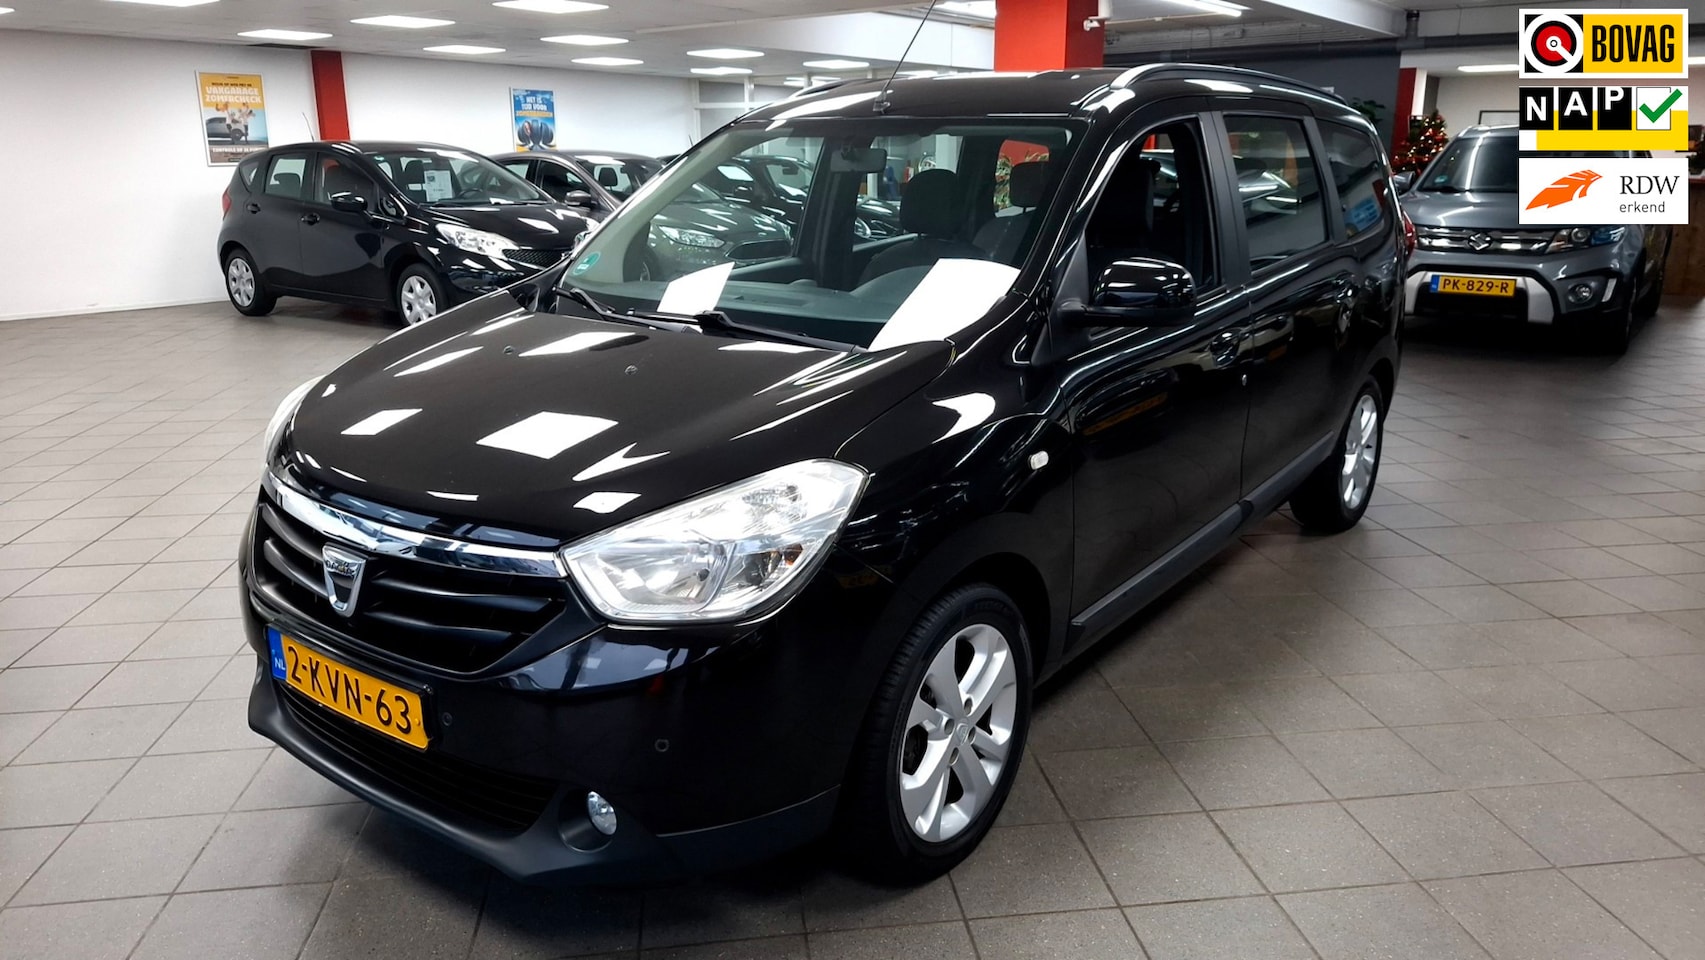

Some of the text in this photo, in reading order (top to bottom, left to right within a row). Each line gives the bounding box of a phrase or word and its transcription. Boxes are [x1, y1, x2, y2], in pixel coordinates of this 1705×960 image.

[206, 86, 258, 95] VAKGARAGE
[206, 94, 262, 104] ZOMERCHECK
[1443, 278, 1509, 293] PK-829-R
[274, 657, 286, 670] NL
[288, 646, 411, 734] 2-KVN-63
